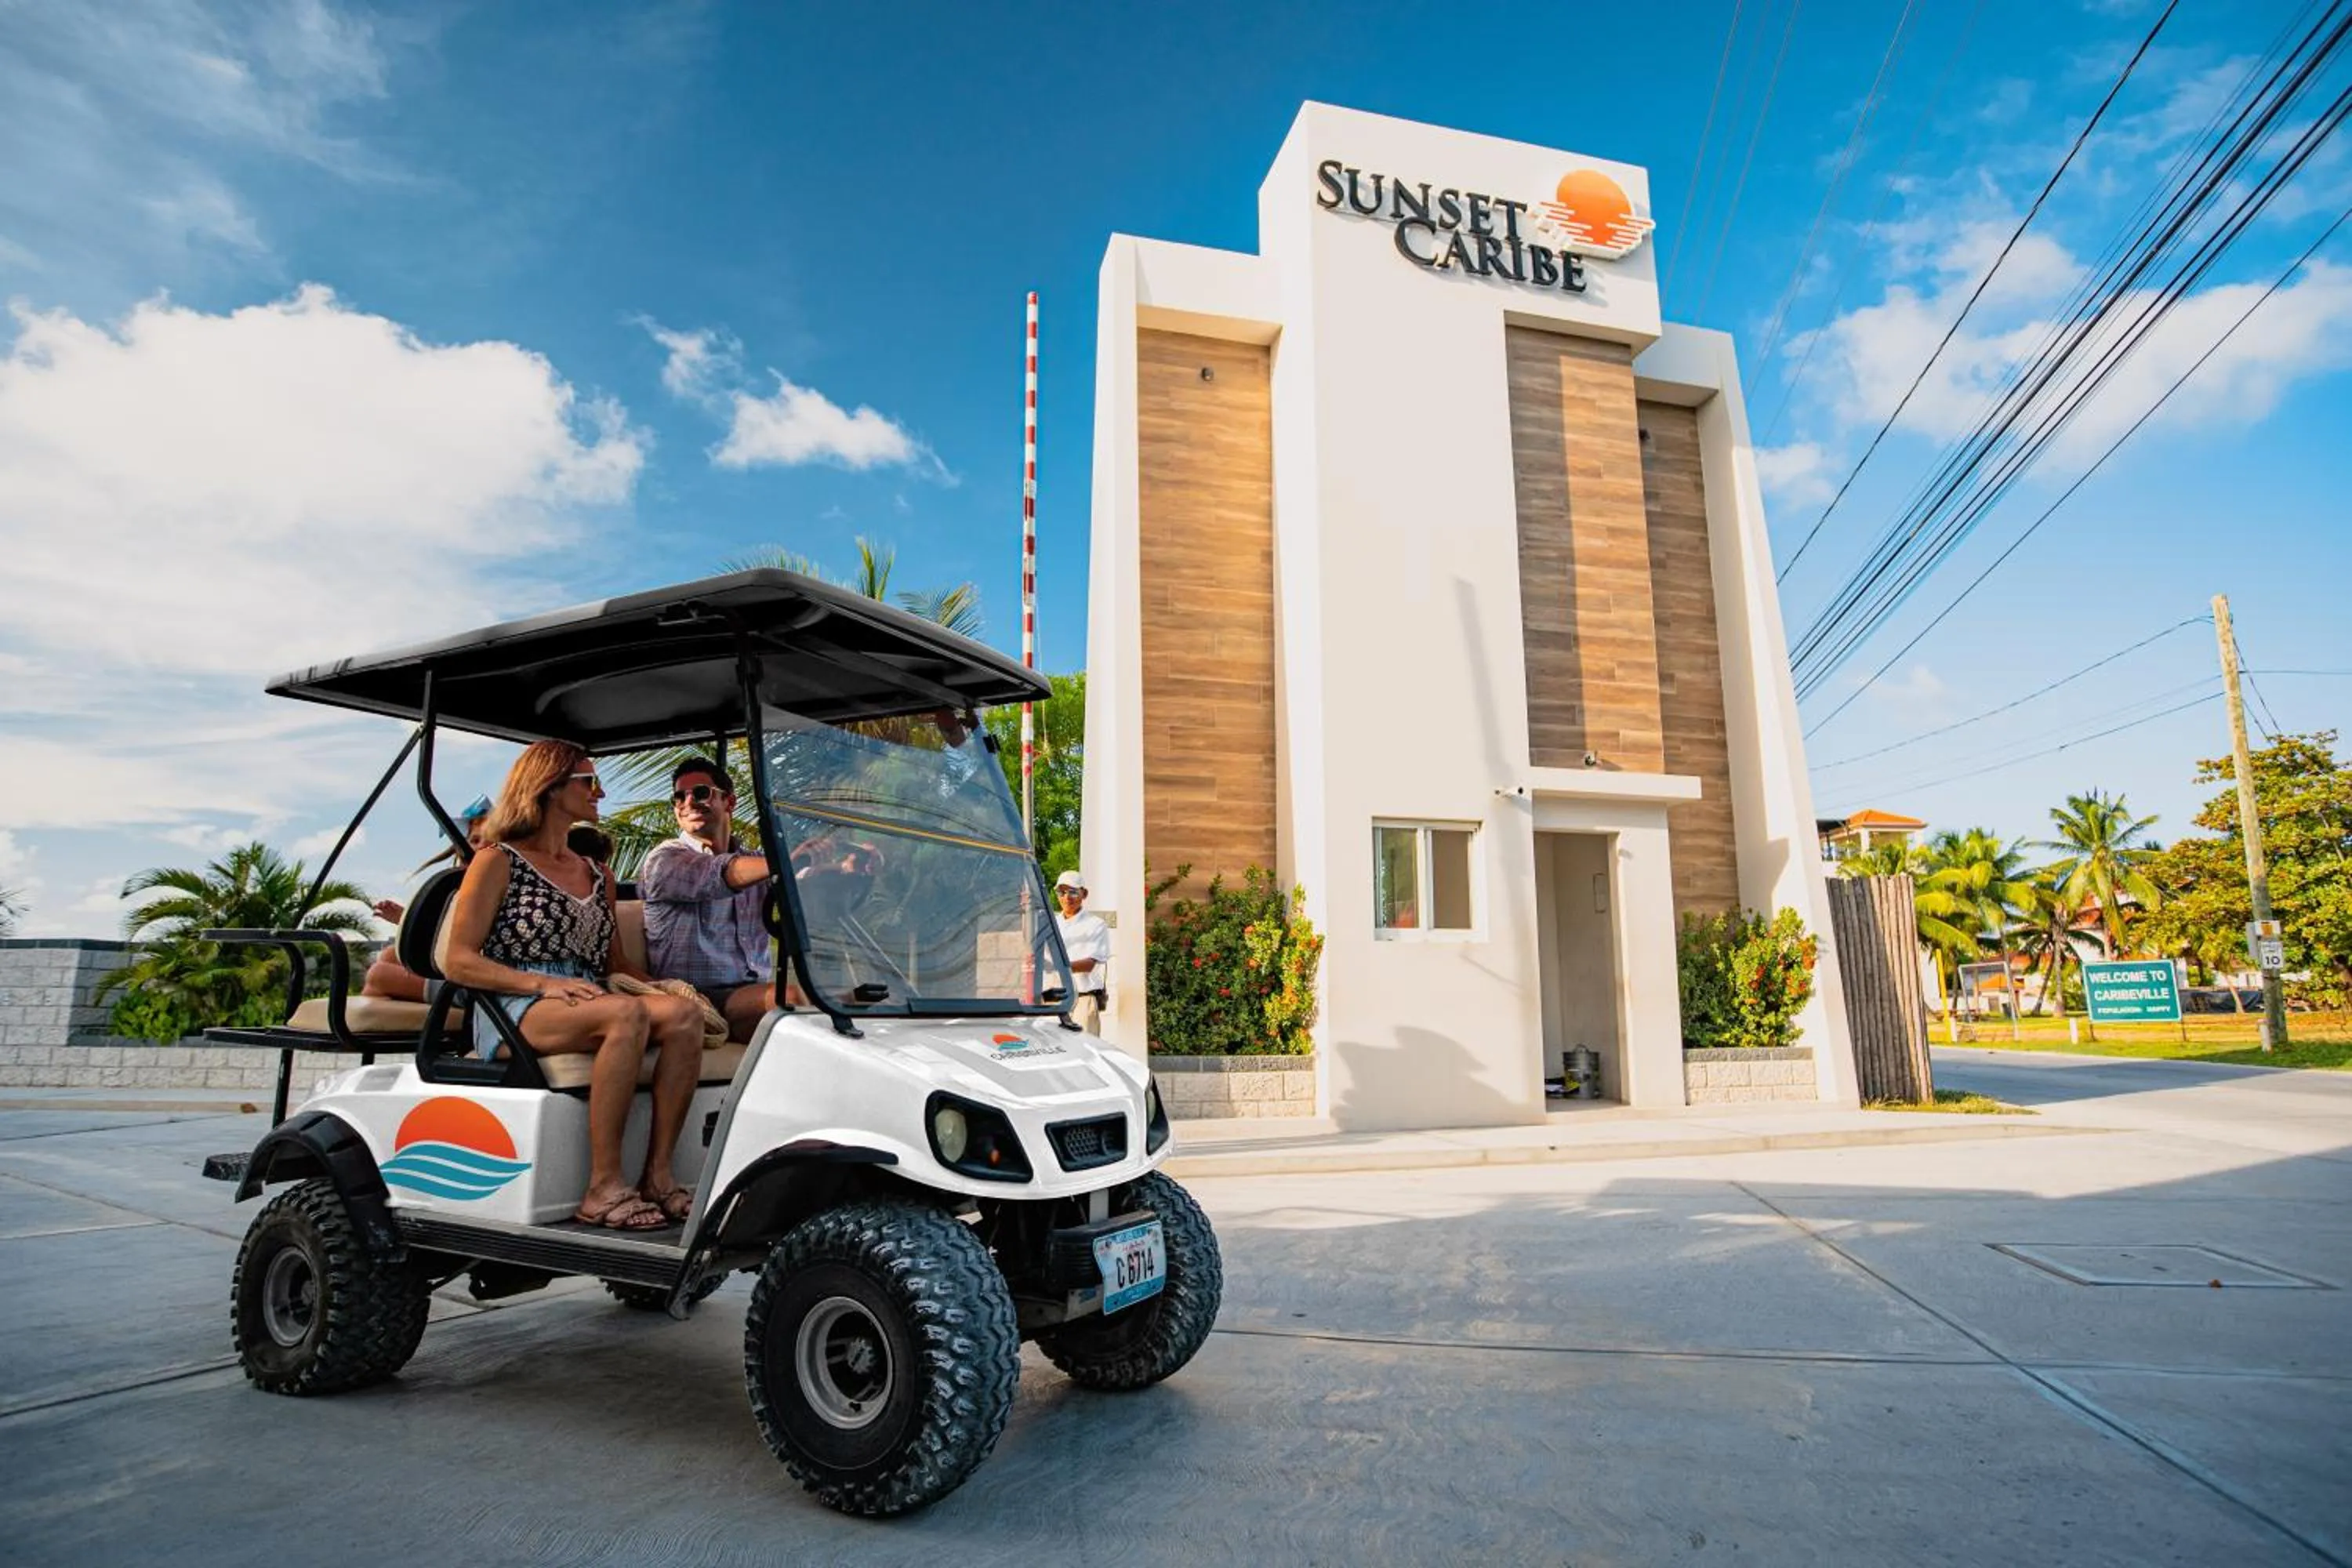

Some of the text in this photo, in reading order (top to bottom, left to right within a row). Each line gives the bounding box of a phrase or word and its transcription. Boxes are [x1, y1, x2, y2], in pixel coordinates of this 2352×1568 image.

[1317, 159, 1527, 241] SUNSET
[1394, 216, 1588, 293] CARIBE
[2088, 970, 2167, 984] WELCOME TO
[2265, 956, 2281, 965] 10
[1127, 1247, 1155, 1285] 6714
